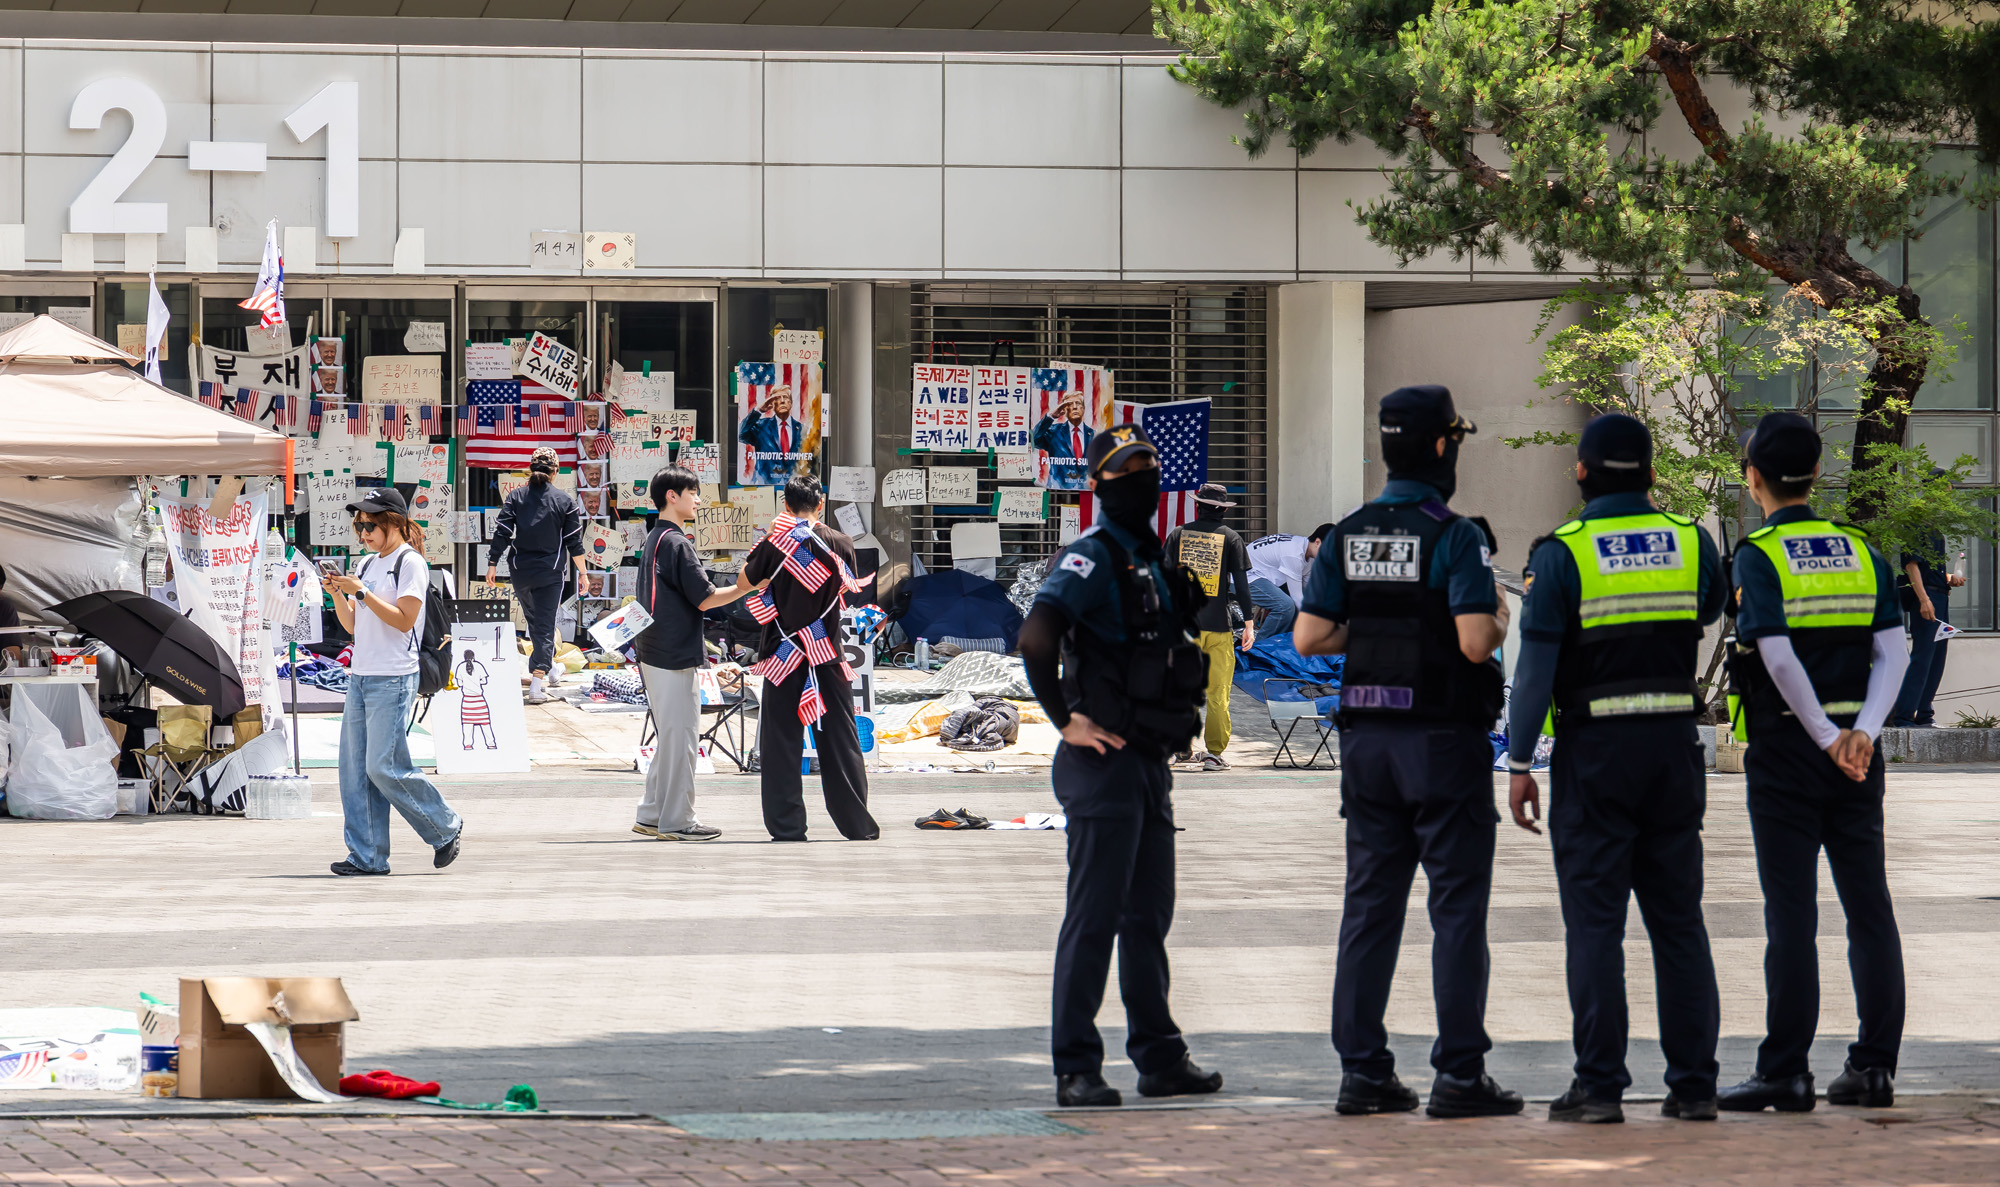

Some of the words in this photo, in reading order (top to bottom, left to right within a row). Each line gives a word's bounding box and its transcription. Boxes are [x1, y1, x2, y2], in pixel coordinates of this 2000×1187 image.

[69, 76, 359, 238] 2-1
[937, 387, 970, 404] WEB
[993, 430, 1028, 447] WEB
[747, 451, 783, 461] PATRIOTIC
[784, 452, 813, 461] SUMMER
[1041, 457, 1077, 466] PATRIOTIC
[696, 505, 749, 525] FREEDOM
[698, 527, 710, 547] IS
[710, 525, 731, 545] NOT
[731, 525, 751, 542] FREE
[1609, 554, 1672, 568] POLICE
[1797, 558, 1851, 570] POLICE
[1355, 563, 1408, 575] POLICE
